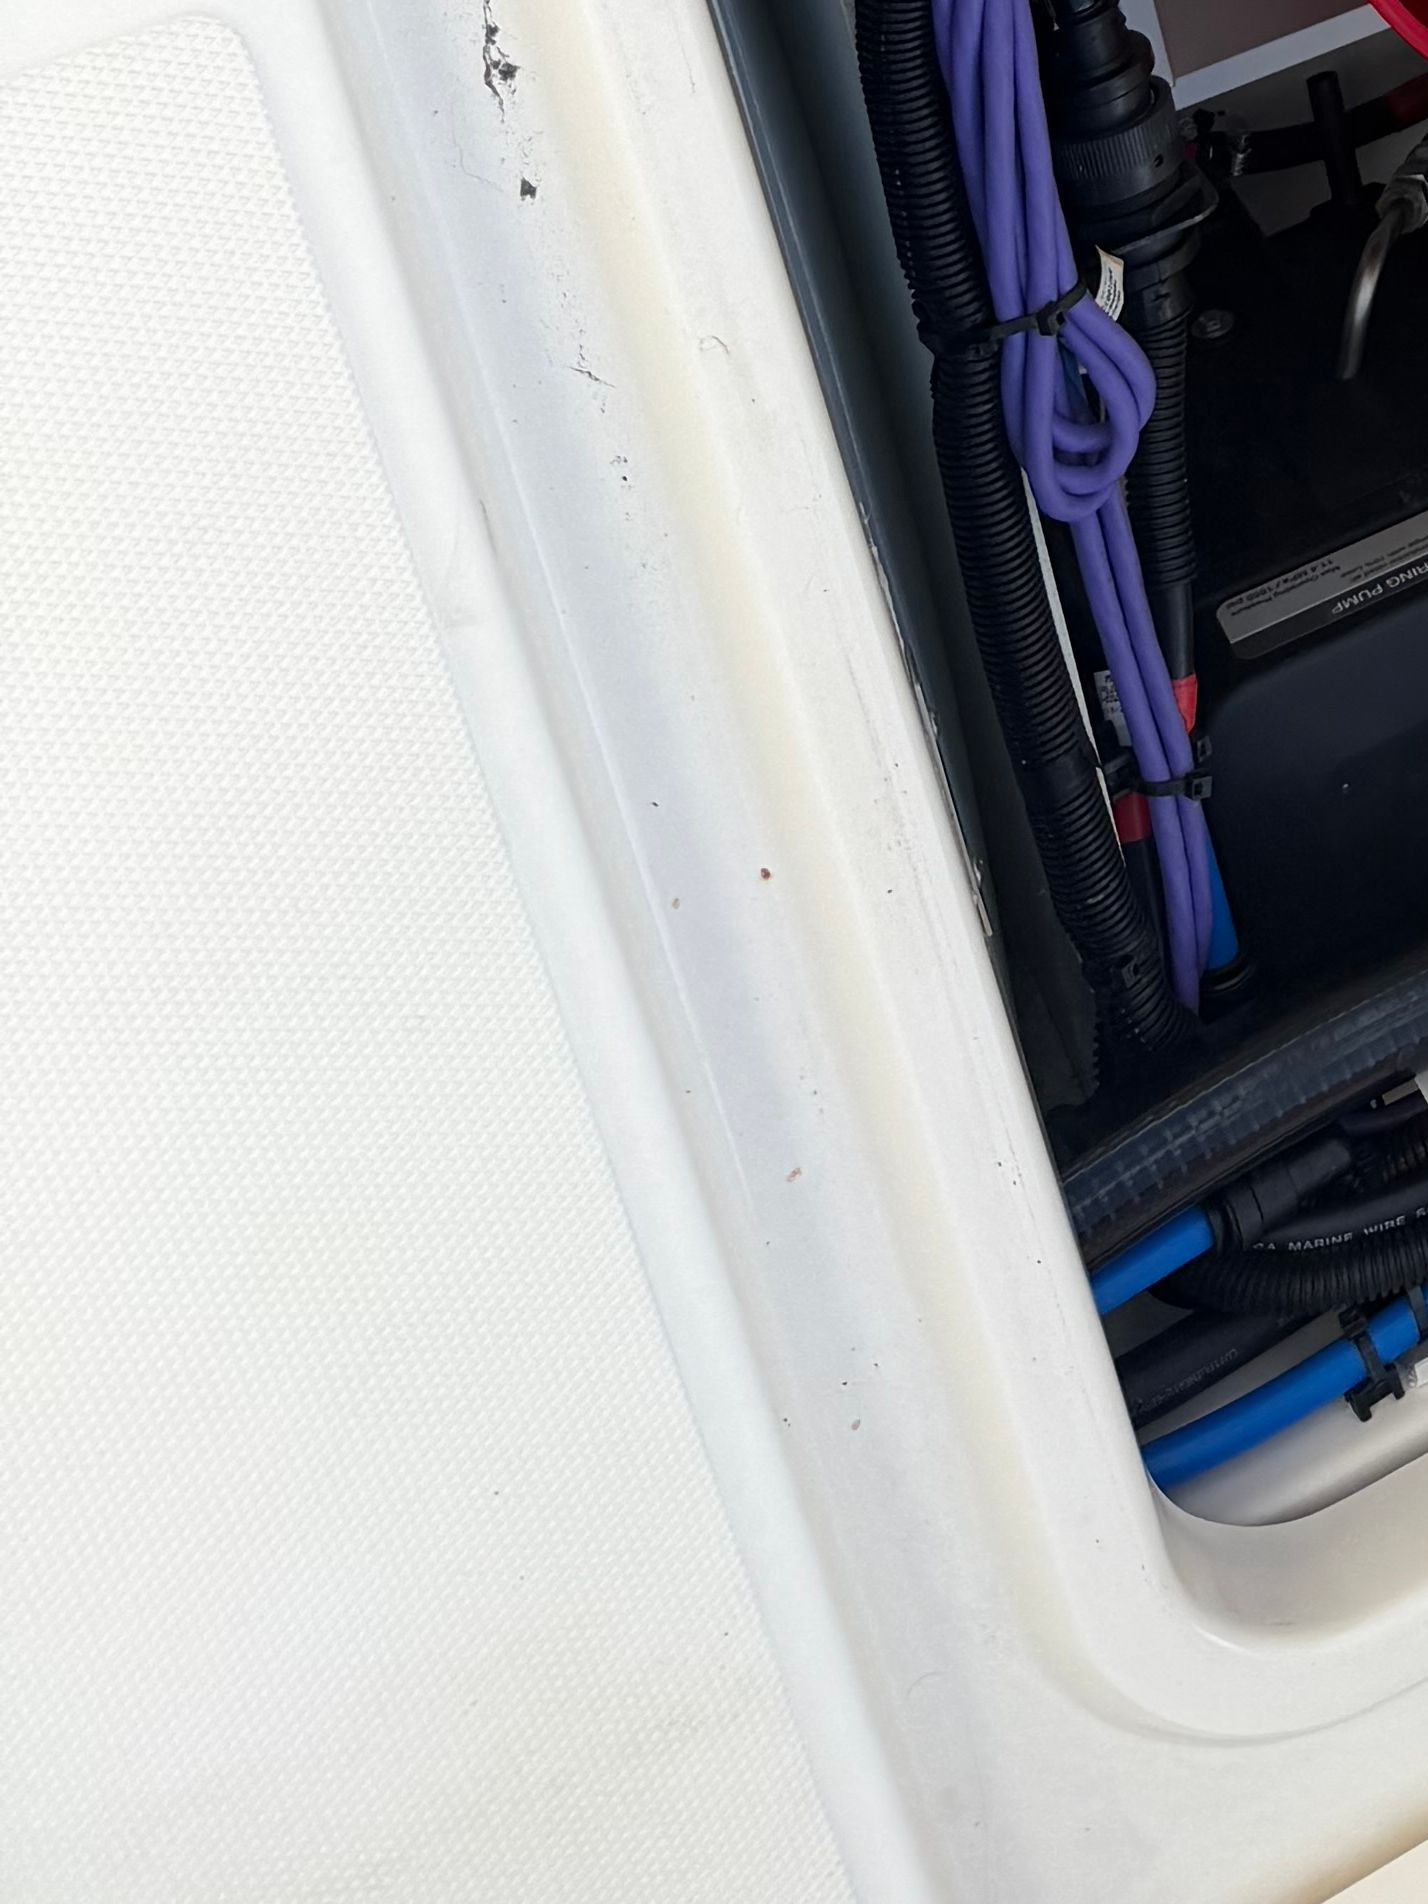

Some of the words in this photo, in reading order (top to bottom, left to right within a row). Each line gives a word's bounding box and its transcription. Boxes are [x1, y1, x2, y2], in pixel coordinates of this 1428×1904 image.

[1328, 580, 1383, 616] PUMP
[1286, 1232, 1353, 1251] MARINE
[1363, 1214, 1407, 1235] WIRE
